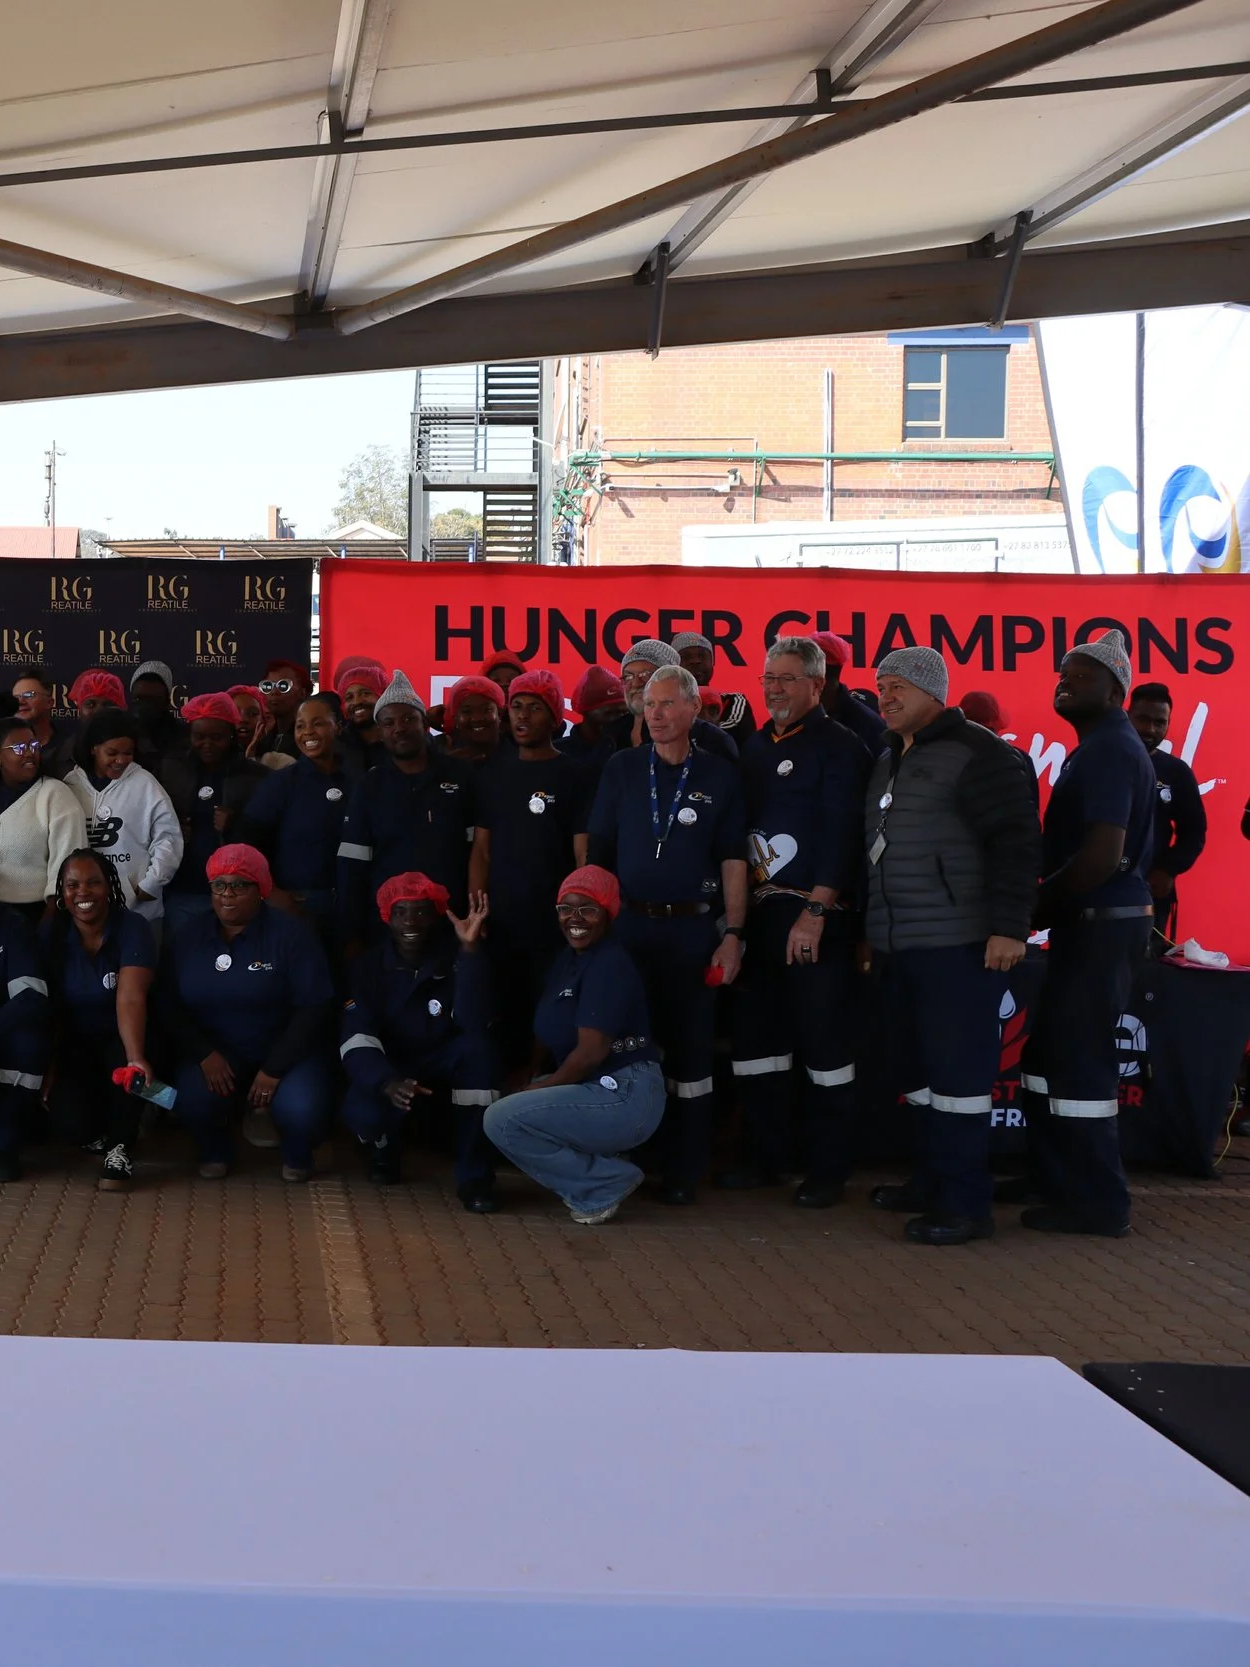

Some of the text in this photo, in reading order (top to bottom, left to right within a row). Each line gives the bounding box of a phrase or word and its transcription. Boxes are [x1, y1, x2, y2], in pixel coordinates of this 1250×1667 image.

[52, 577, 91, 600] RG
[148, 576, 188, 599] RG
[245, 576, 285, 600] RG
[51, 601, 92, 609] REATILE
[147, 600, 188, 608] REATILE
[244, 601, 285, 609] REATILE
[4, 630, 43, 653] RG
[100, 630, 139, 653] RG
[197, 631, 236, 654] RG
[3, 654, 44, 662] REATILE
[99, 655, 141, 663] REATILE
[196, 656, 237, 664] REATILE
